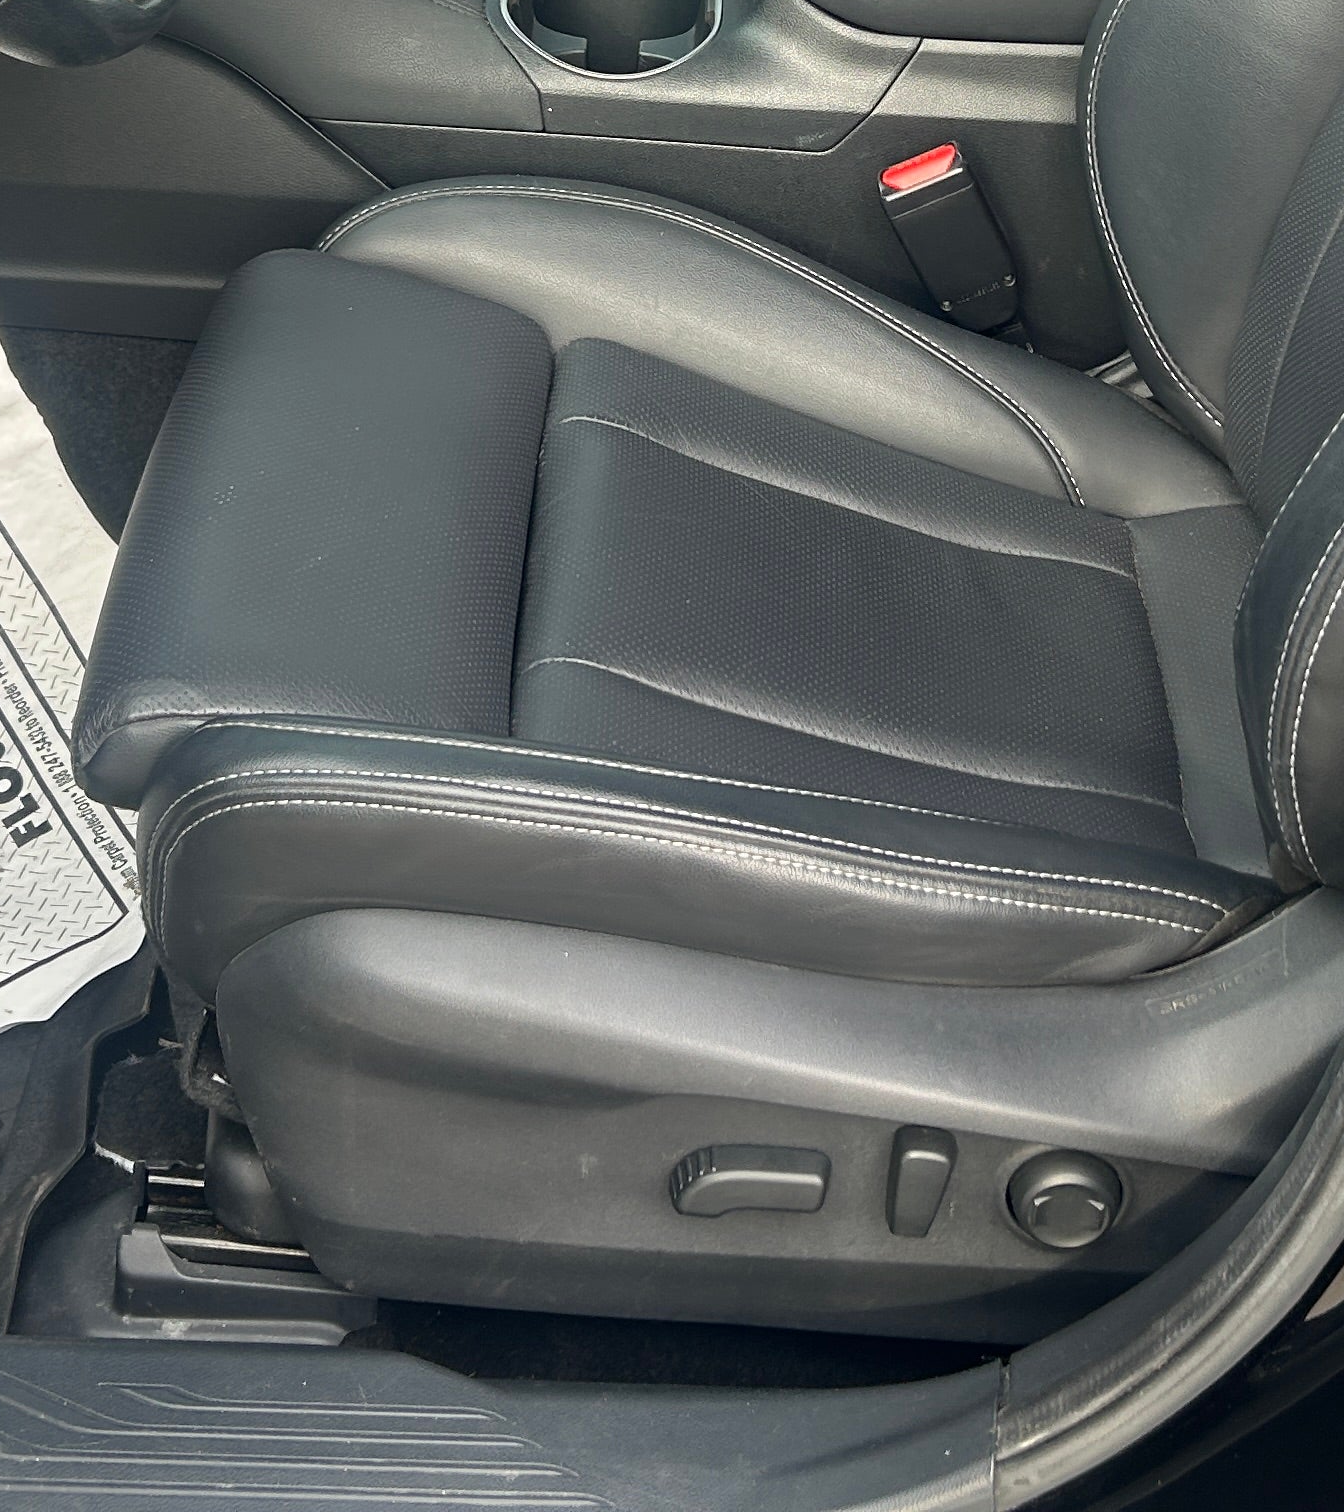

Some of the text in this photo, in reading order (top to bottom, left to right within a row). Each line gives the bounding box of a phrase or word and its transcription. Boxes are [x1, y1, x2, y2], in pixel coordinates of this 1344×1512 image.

[4, 682, 31, 723] Reorder
[25, 717, 40, 730] to
[26, 728, 66, 773] 247-5432
[73, 795, 111, 846] Protection
[104, 837, 129, 871] Carpet
